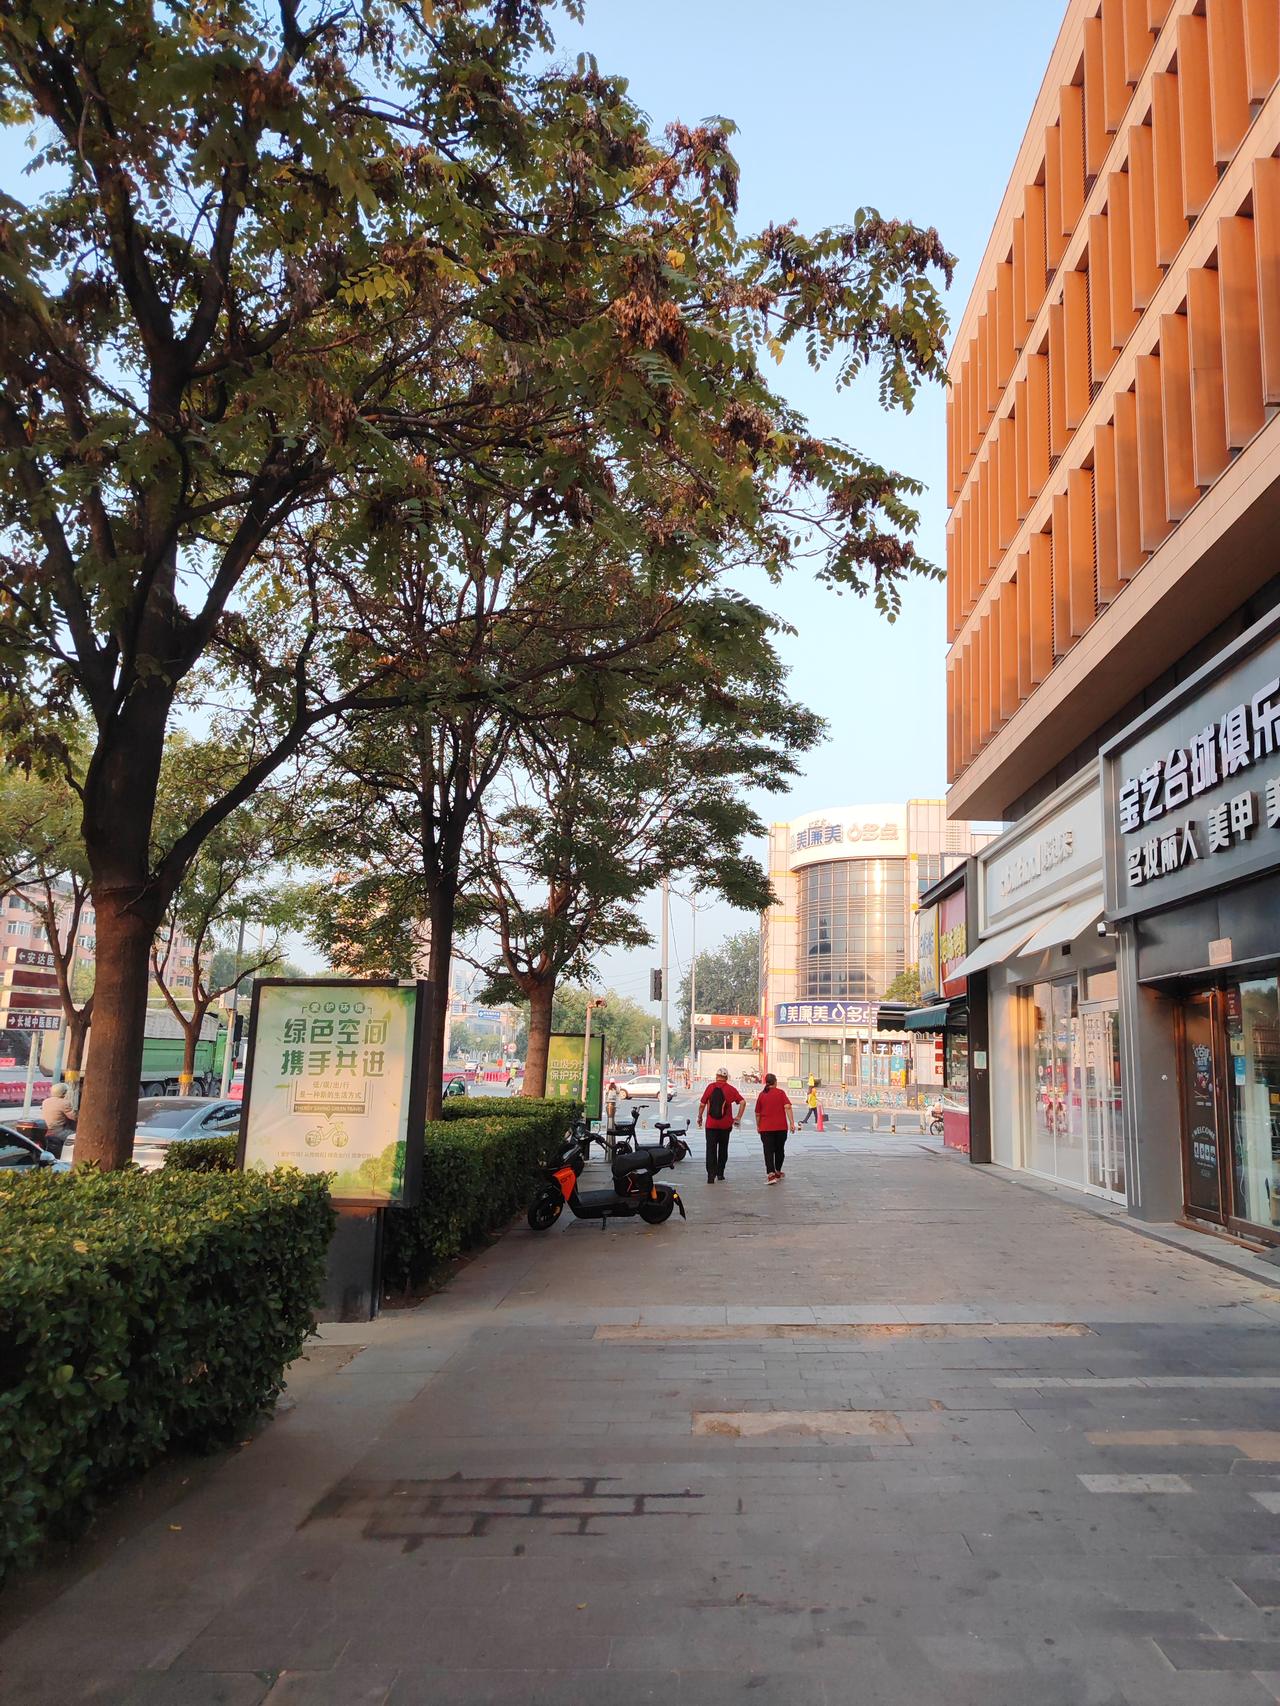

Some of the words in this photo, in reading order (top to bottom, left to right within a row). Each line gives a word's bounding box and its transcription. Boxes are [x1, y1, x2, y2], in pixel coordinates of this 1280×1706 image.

[796, 824, 842, 850] 美廉美
[862, 823, 899, 841] 多点
[1127, 820, 1199, 887] 名妆丽人
[1208, 790, 1253, 853] 美甲
[27, 952, 55, 966] 安达医
[17, 1015, 59, 1028] 长城中医医院
[787, 1005, 828, 1022] 美廉美
[283, 1018, 388, 1044] 绿色空间
[863, 1043, 903, 1055] 电子烟
[281, 1050, 384, 1077] 携手共进
